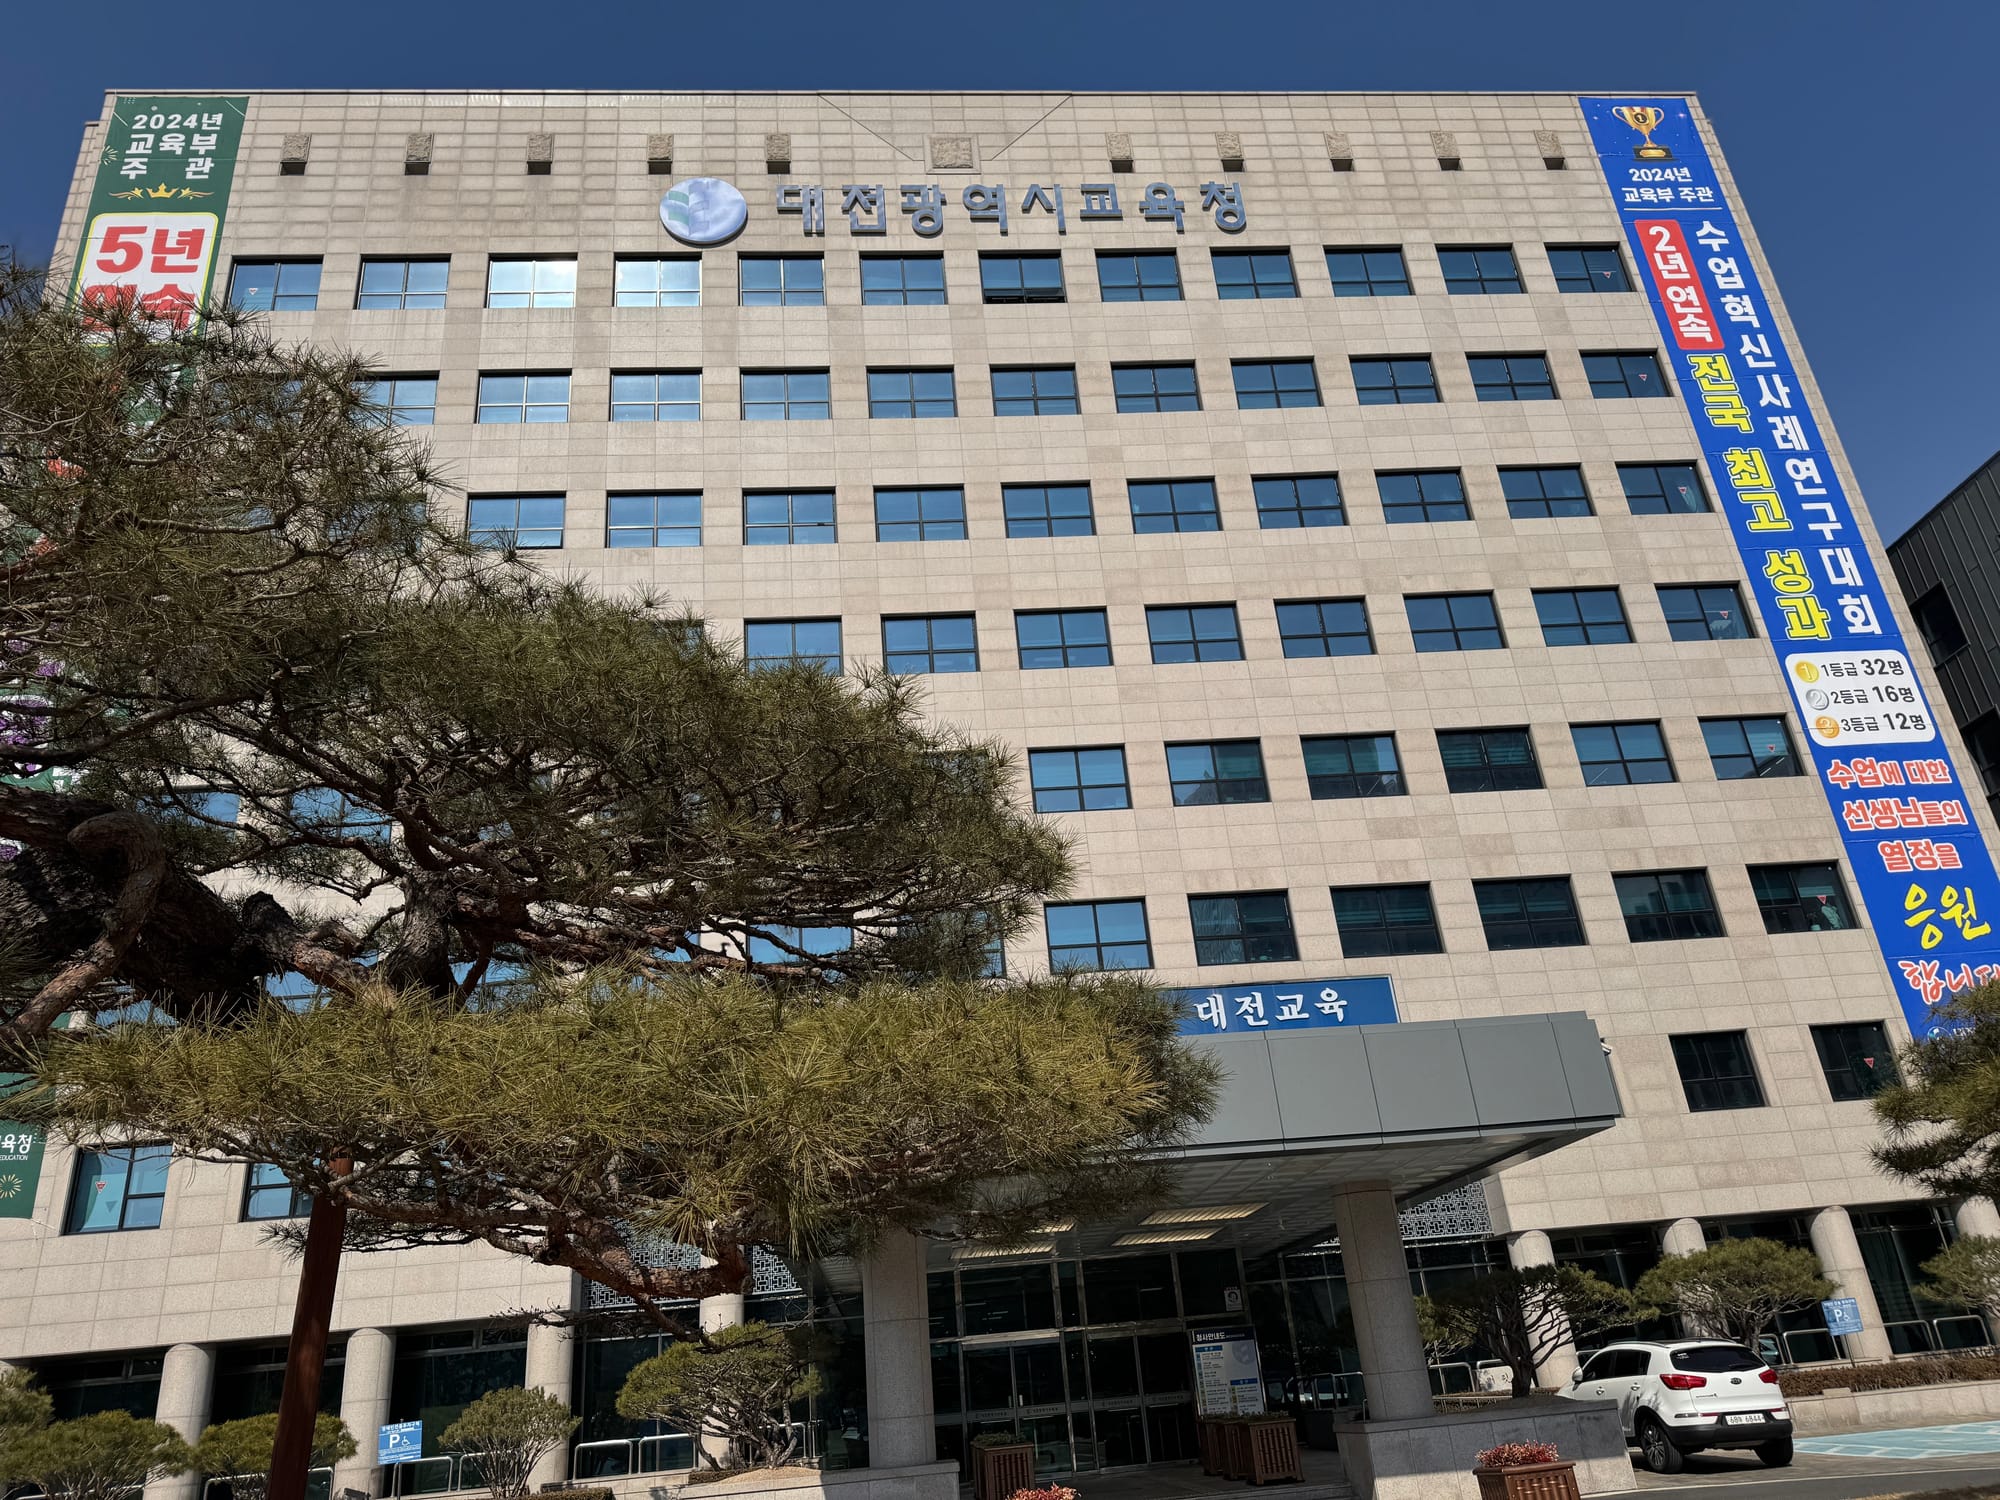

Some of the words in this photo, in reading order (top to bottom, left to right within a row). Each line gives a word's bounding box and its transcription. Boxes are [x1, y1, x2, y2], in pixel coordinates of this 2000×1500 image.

[131, 113, 223, 130] 2024년
[125, 133, 217, 155] 교육부
[1628, 167, 1692, 182] 2024년
[775, 181, 1246, 237] 대전광역시교육청
[1621, 187, 1675, 203] 교육부
[1679, 187, 1714, 202] 주관
[96, 226, 205, 273] 5년
[1649, 226, 1691, 279] 2년
[1666, 285, 1713, 342] 연속
[1696, 220, 1882, 635] 수업혁신사례연구대회
[1687, 353, 1754, 433] 전국
[1723, 448, 1794, 532] 최고
[1764, 549, 1831, 640] 성과
[1821, 662, 1858, 677] 1등급
[1861, 659, 1904, 676] 32명
[1830, 689, 1869, 704] 2등급
[1872, 685, 1915, 703] 16명
[1841, 717, 1880, 732] 3등급
[1883, 713, 1927, 730] 12명
[1827, 757, 1905, 789] 수업에
[1903, 759, 1952, 784] 대한
[1842, 797, 1969, 831] 선생님들의
[1878, 839, 1963, 873] 열정을
[1904, 883, 1991, 950] 응원
[1194, 987, 1348, 1030] 대전교육
[0, 1133, 33, 1154] 육청
[1834, 1309, 1843, 1323] P
[389, 1434, 400, 1448] P
